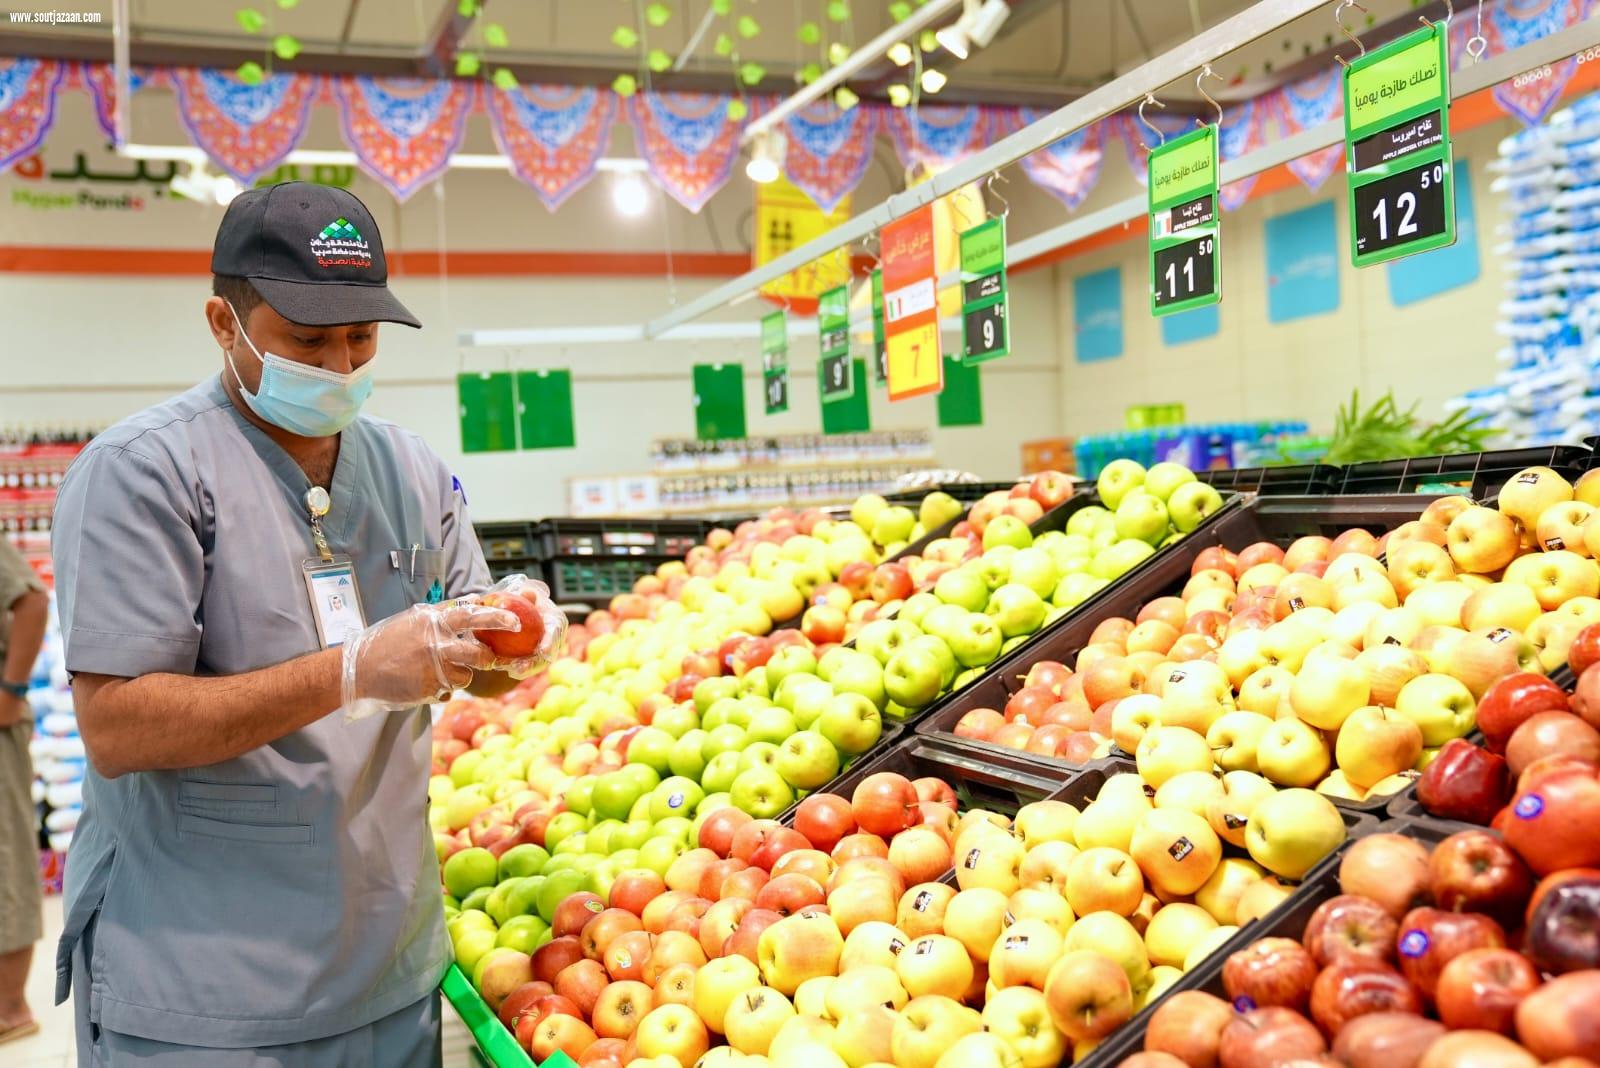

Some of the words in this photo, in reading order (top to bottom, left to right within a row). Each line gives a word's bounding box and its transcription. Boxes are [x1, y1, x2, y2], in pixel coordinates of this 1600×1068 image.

[1409, 63, 1437, 86] تصلك
[1380, 79, 1407, 99] طازجة
[1417, 119, 1432, 137] تفاح
[1172, 166, 1190, 182] طازجة
[1421, 165, 1442, 189] 50
[1372, 191, 1418, 240] 12
[1199, 239, 1213, 256] 50
[1165, 256, 1195, 298] 11
[983, 319, 994, 349] 9
[911, 344, 920, 378] 7
[833, 362, 842, 386] 9
